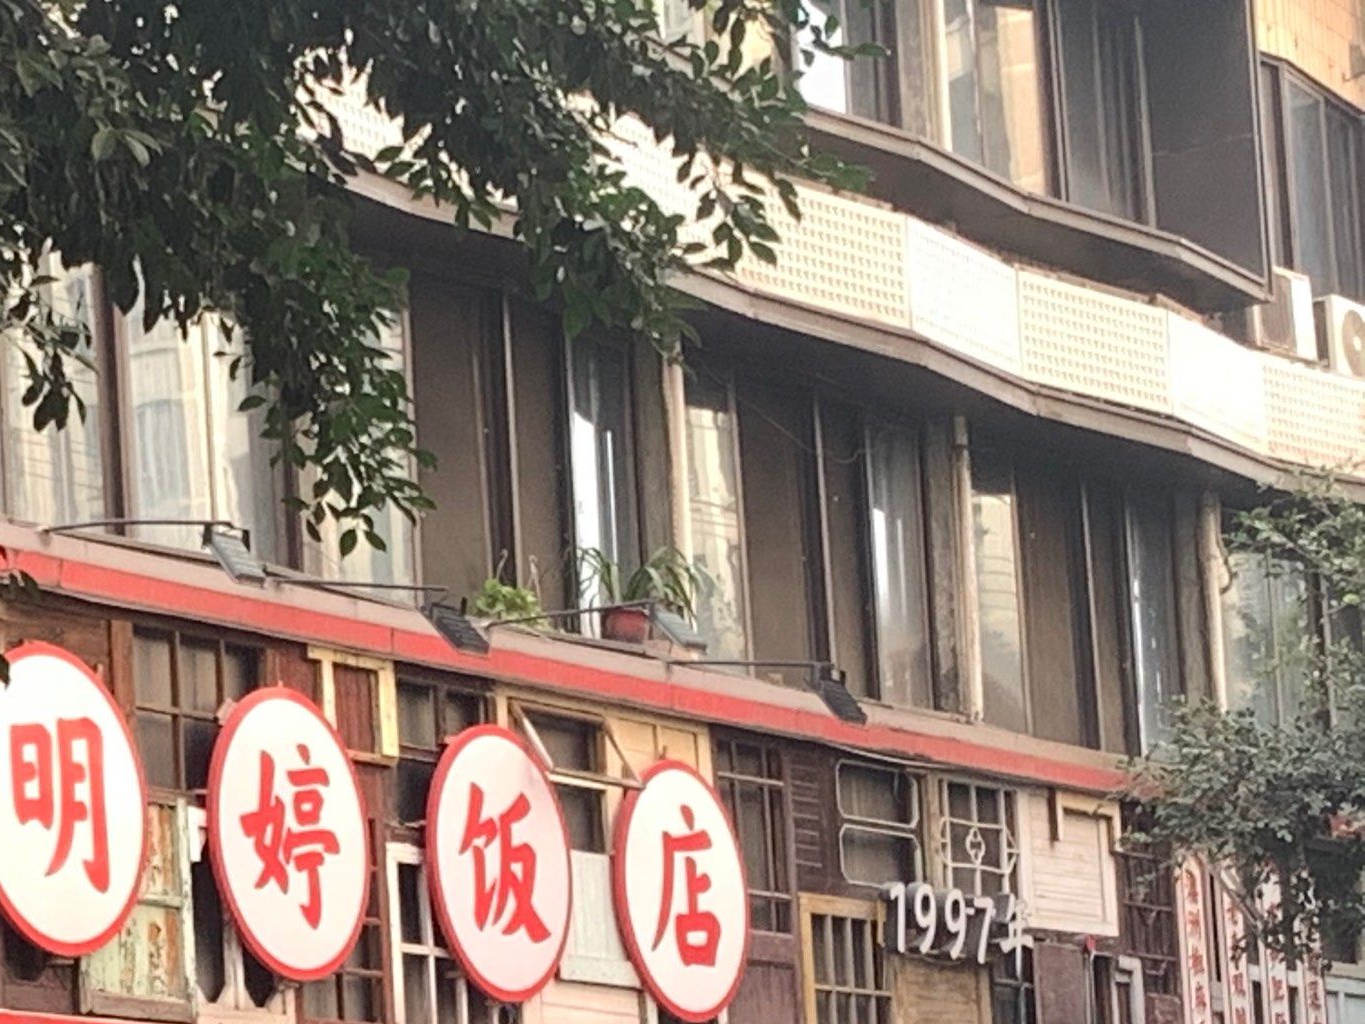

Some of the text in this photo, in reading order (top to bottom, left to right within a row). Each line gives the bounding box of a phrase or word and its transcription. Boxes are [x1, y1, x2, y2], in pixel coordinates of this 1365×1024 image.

[8, 716, 724, 968] 明婷饭店
[887, 880, 1035, 982] 1997年
